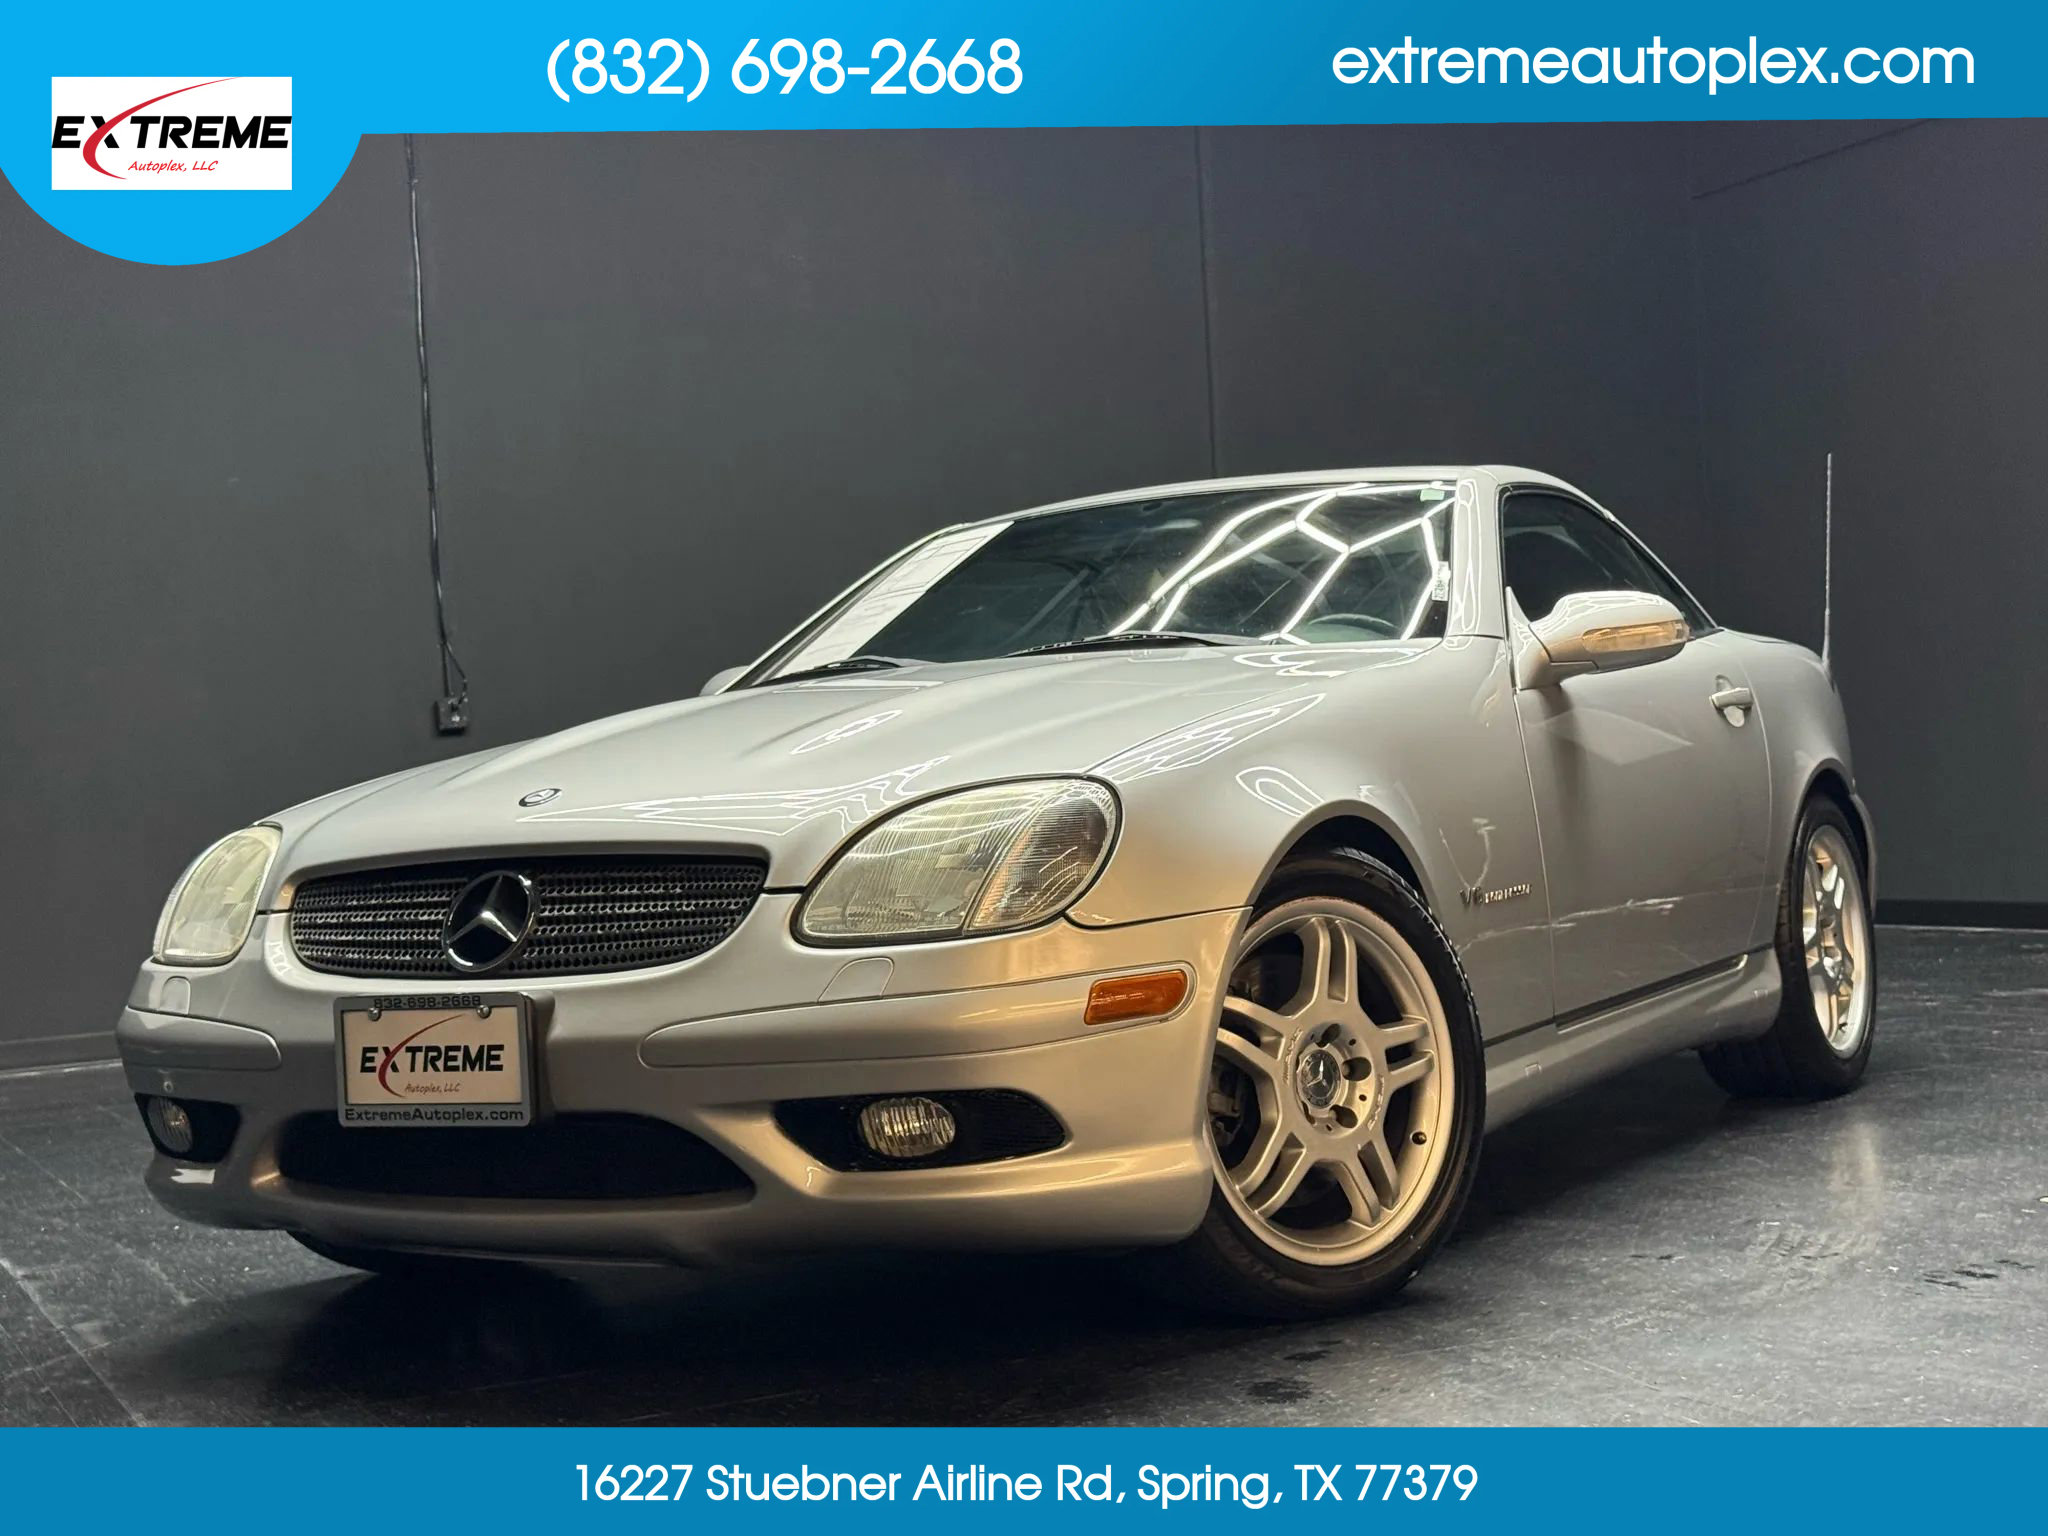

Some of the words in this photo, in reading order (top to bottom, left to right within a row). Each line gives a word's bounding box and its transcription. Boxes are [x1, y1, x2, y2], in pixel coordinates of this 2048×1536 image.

[360, 1044, 505, 1073] EXTREME
[444, 1083, 461, 1093] LLC
[345, 1107, 524, 1123] ExtremeAutoplex.com
